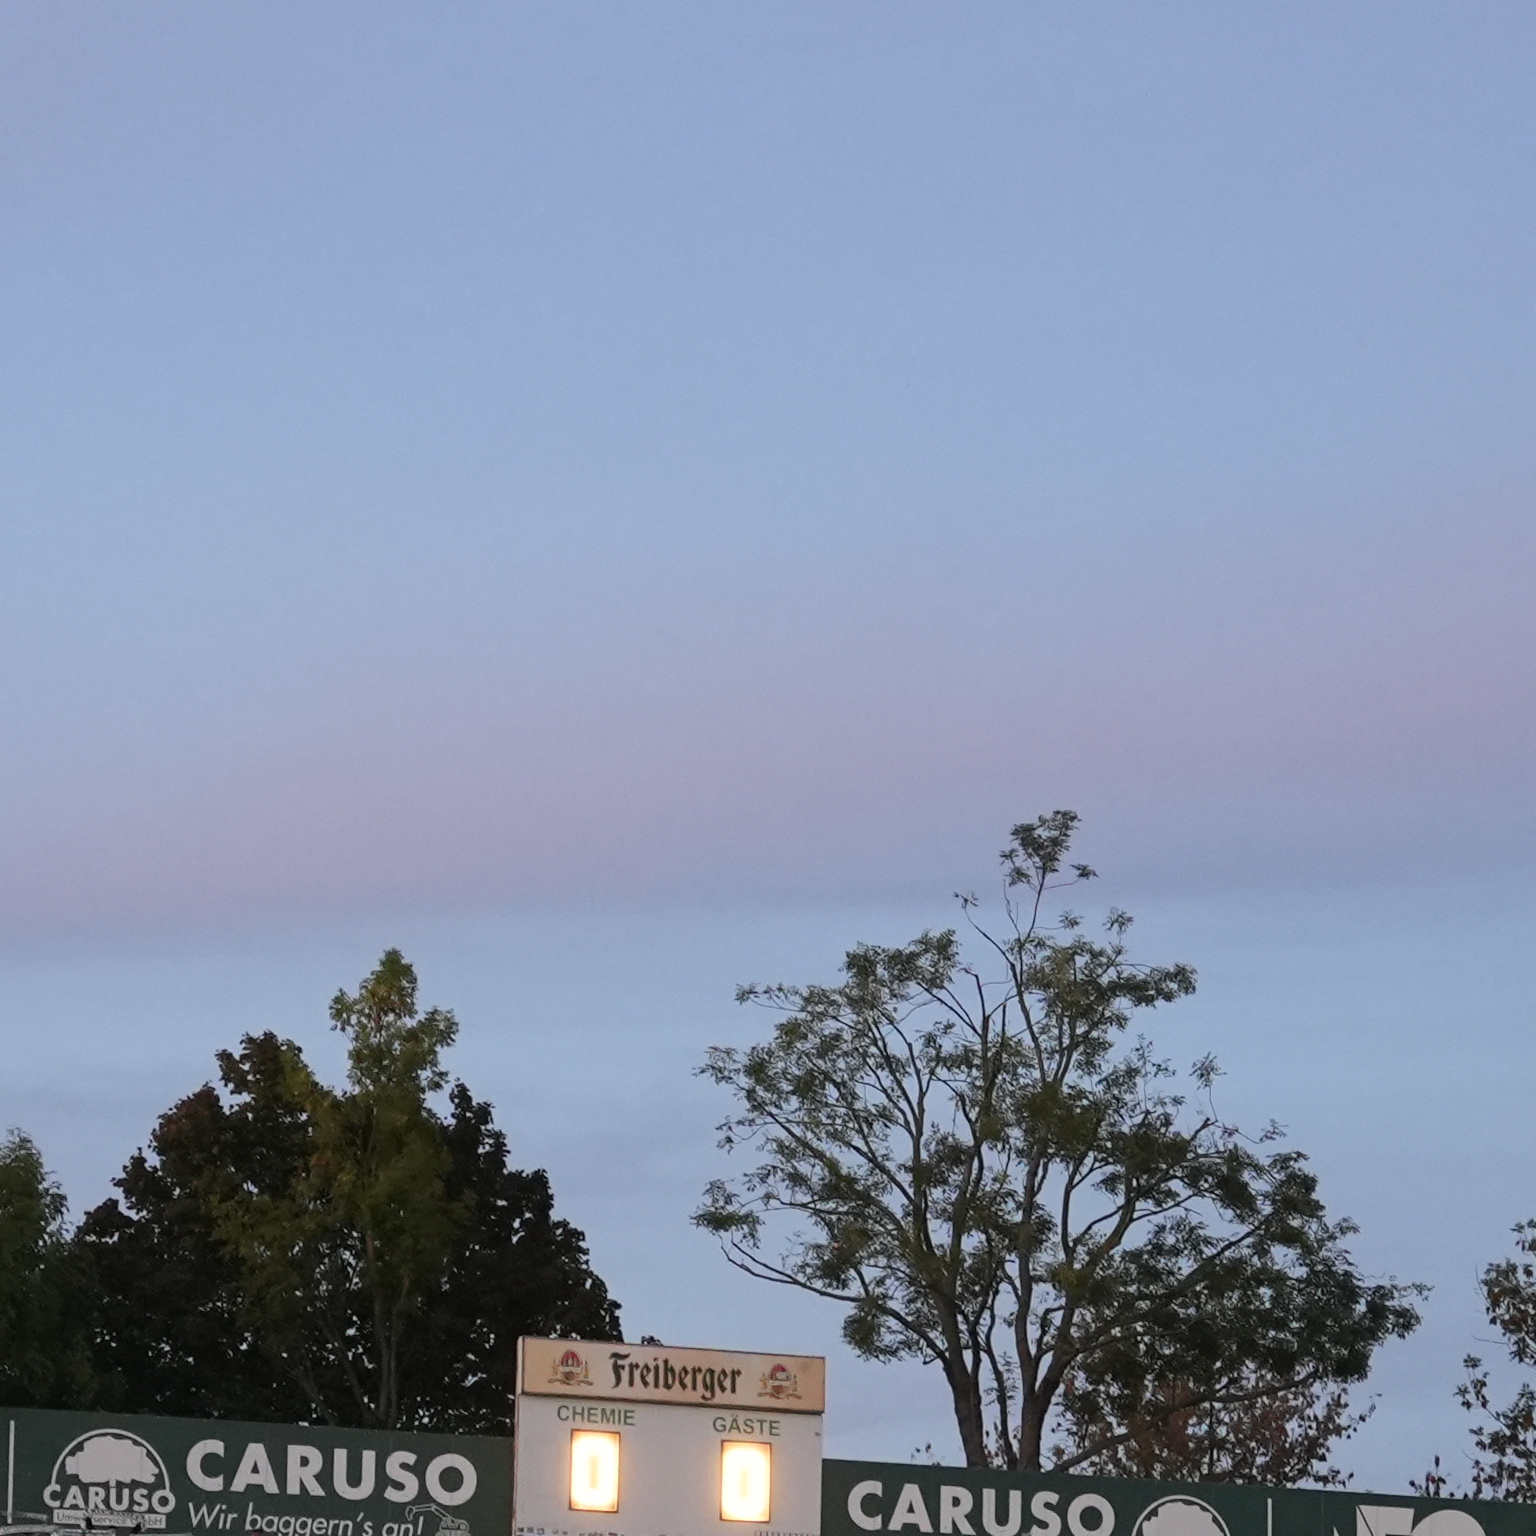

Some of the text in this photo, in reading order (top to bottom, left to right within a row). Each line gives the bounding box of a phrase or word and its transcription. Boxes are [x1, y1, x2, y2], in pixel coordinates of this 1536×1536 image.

[609, 1352, 742, 1401] Freiberger
[557, 1404, 635, 1427] CHEMIE
[713, 1413, 781, 1438] GÄSTE
[185, 1438, 478, 1507] CARUSO
[43, 1483, 176, 1515] CARUSO
[188, 1501, 238, 1531] Wir
